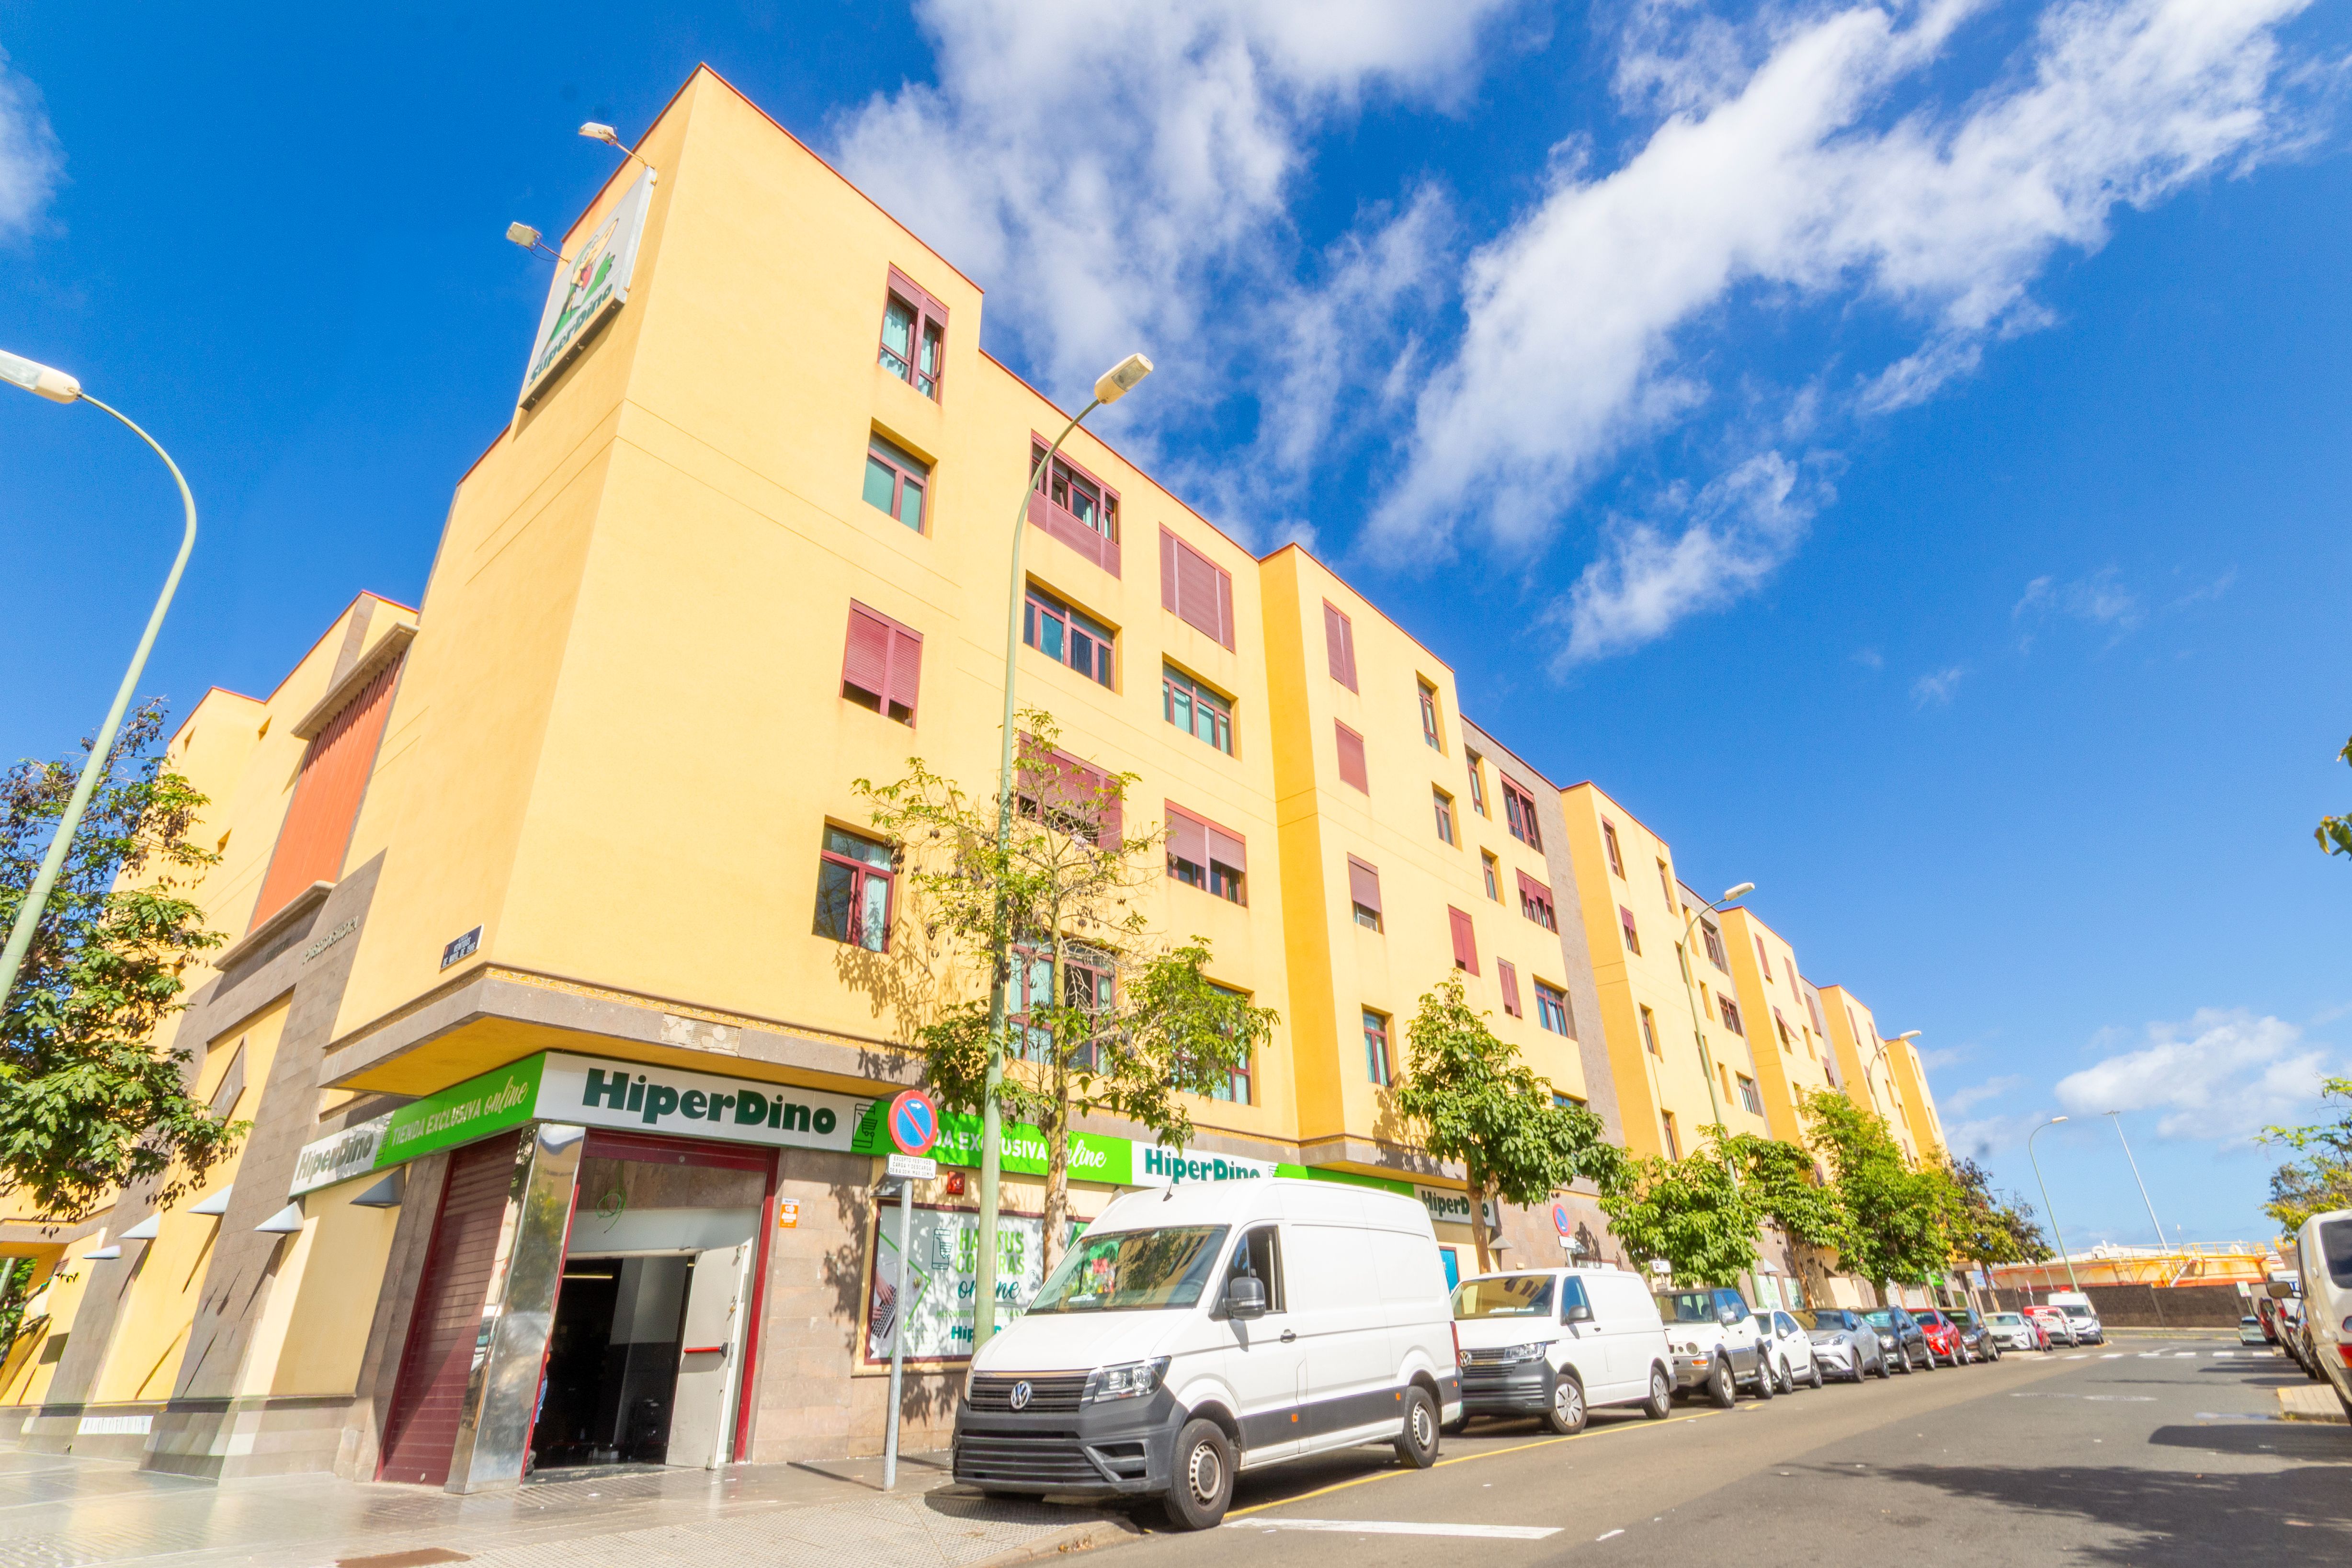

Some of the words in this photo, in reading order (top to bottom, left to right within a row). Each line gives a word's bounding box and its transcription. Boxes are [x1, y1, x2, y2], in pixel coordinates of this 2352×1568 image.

[528, 283, 613, 387] SuperDino
[391, 1117, 426, 1147] TIENDA
[426, 1098, 480, 1135] EXCLUSIVA
[483, 1075, 529, 1116] online
[582, 1068, 837, 1135] HiperDino
[295, 1133, 374, 1184] HiperDino
[959, 1132, 1047, 1161] EXUSIVA
[1421, 1190, 1489, 1217] HiperDo
[959, 1227, 978, 1251] HA
[955, 1252, 1025, 1275] CORAS
